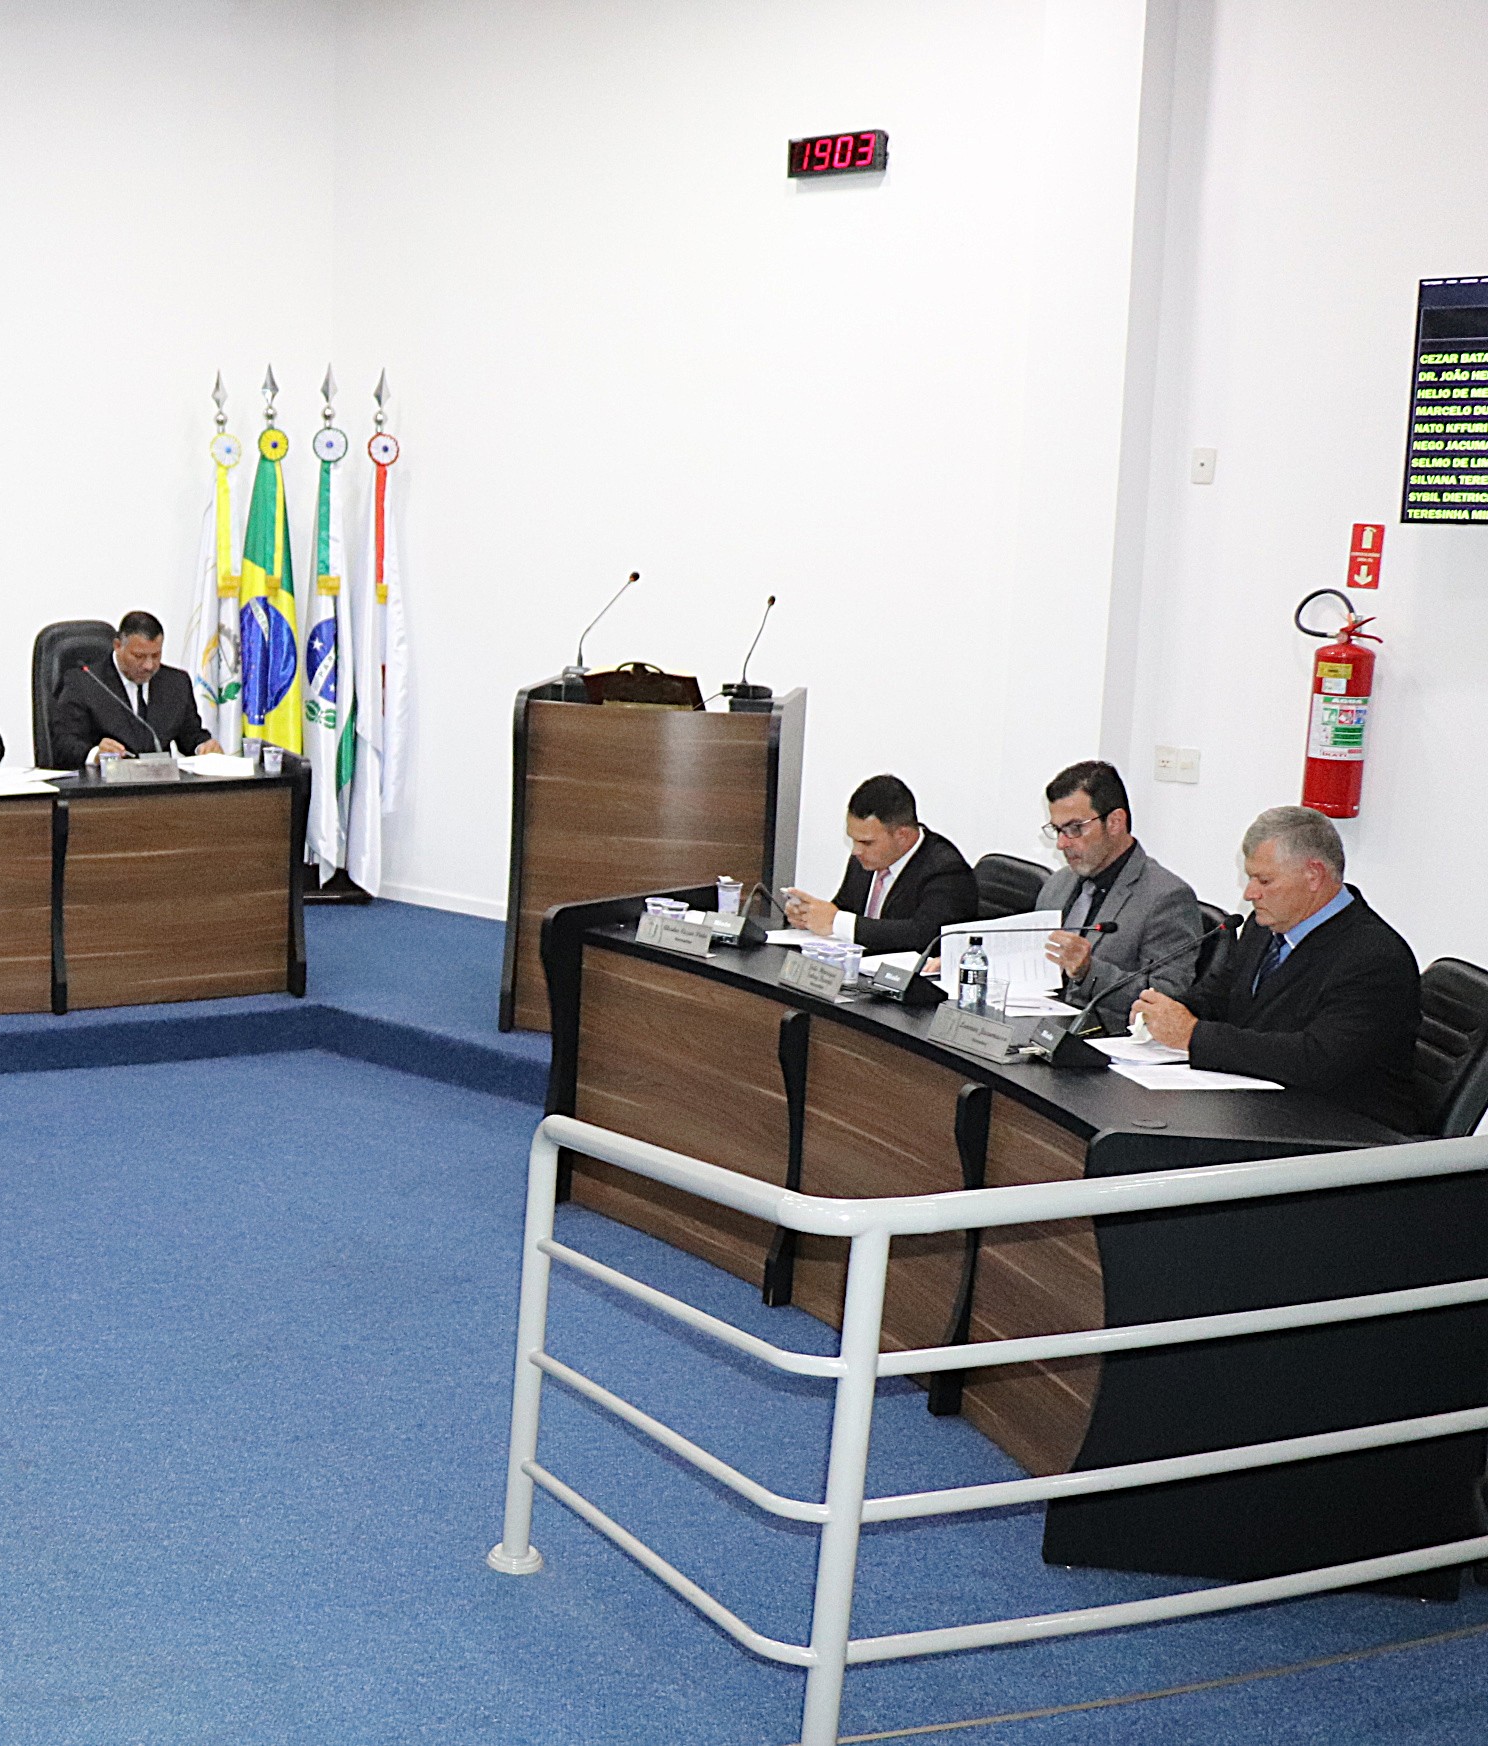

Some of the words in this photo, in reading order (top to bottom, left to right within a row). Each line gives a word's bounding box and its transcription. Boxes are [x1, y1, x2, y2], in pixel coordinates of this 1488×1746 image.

[802, 133, 876, 171] 1903
[1420, 353, 1459, 364] CEZAR
[1418, 371, 1438, 381] DR.
[1439, 368, 1470, 381] JOÃO
[1471, 370, 1488, 380] HE
[1417, 388, 1451, 398] HELIO
[1452, 388, 1469, 398] DE
[1415, 405, 1472, 416] MARCELO
[1414, 423, 1444, 433] NATO
[1413, 440, 1445, 450] NEGO
[1411, 457, 1451, 468] SELMO
[1452, 457, 1469, 468] DE
[1410, 475, 1457, 485] SILVANA
[1408, 492, 1441, 502] SYBIL
[1442, 491, 1488, 502] DIETRIC
[1407, 508, 1470, 519] TERESINHA
[1471, 509, 1488, 519] MI
